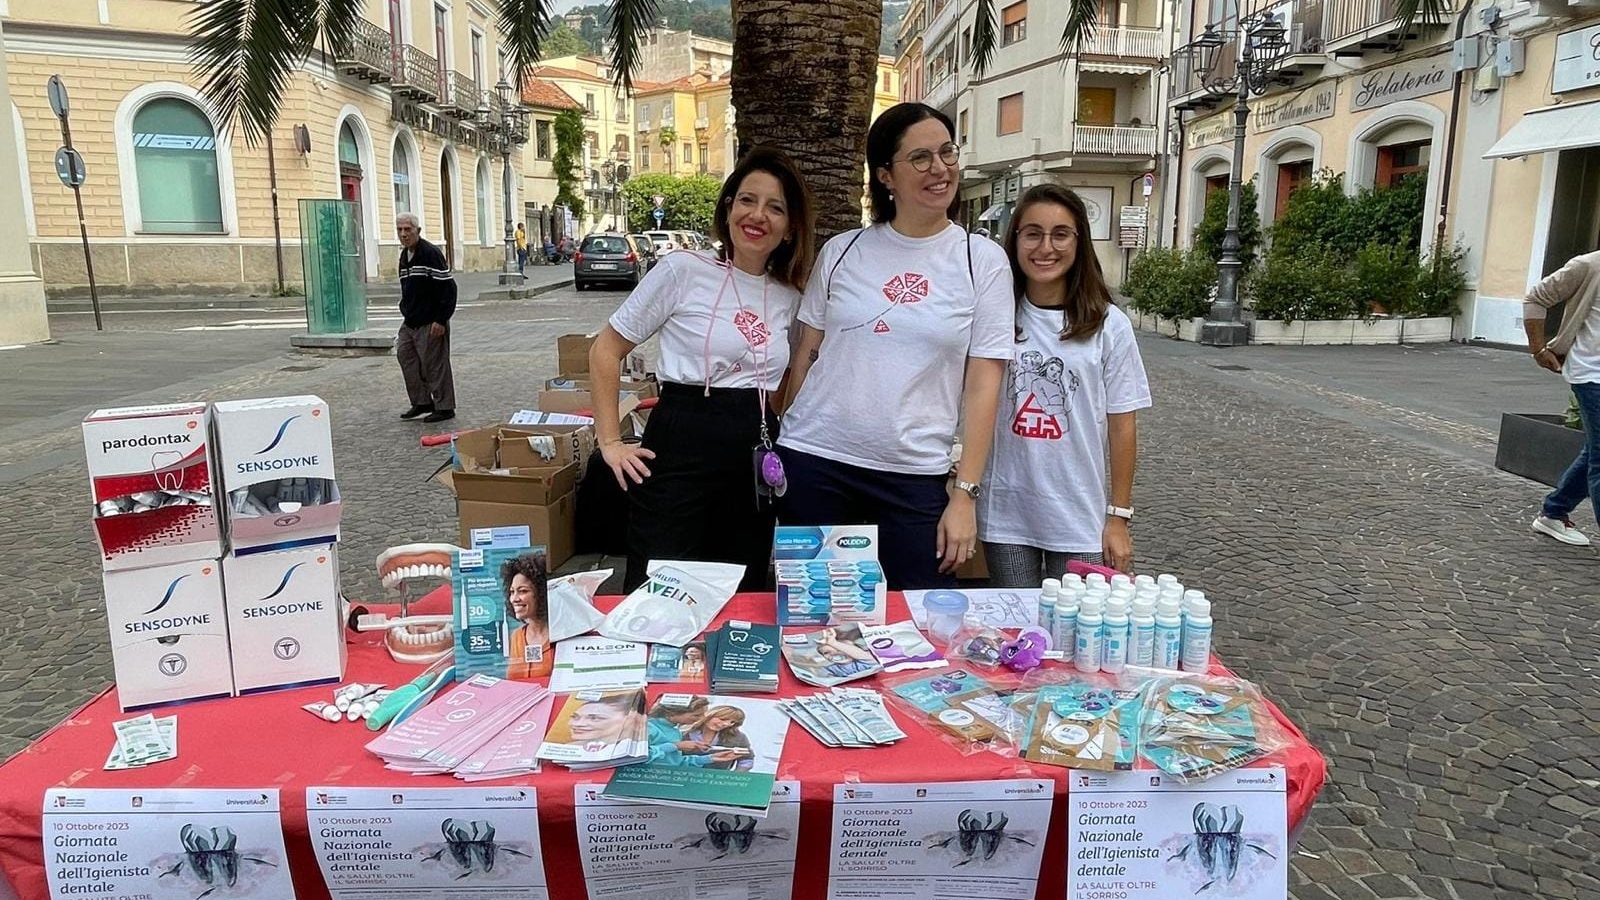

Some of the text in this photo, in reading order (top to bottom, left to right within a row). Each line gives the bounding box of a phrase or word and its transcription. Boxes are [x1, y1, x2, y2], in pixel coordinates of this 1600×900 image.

[1355, 65, 1445, 106] Gelateria
[1315, 91, 1331, 114] 1942
[102, 432, 191, 453] parodontax
[237, 455, 319, 474] SENSODYNE
[243, 601, 324, 619] SENSODYNE
[469, 605, 490, 617] 30%
[125, 613, 211, 634] SENSODYNE
[470, 635, 491, 647] 35%
[1078, 800, 1148, 809] 10 Ottobre 2023
[318, 817, 392, 825] 10 Ottobre 2023
[598, 812, 634, 820] Ottobre
[1078, 813, 1136, 826] Giornata
[53, 822, 129, 831] 10 Ottobre 2023
[587, 823, 647, 832] Giornata
[842, 818, 901, 827] Giornata
[320, 828, 382, 838] Giornata
[588, 833, 656, 844] Nazionale
[841, 829, 907, 838] Nazionale
[1078, 831, 1143, 842] Nazionale
[54, 835, 117, 847] Giornata
[323, 841, 392, 851] Nazionale
[840, 839, 922, 849] dell'Igienista
[589, 843, 673, 854] dell'Igienista
[839, 849, 888, 858] dentale
[55, 851, 128, 864] Nazionale
[326, 852, 413, 863] dell'Igienista
[591, 853, 640, 862] dentale
[1077, 848, 1160, 861] dell'Igienista
[330, 863, 381, 872] dentale
[1077, 865, 1126, 876] dentale
[57, 866, 150, 881] dell'Igienista
[60, 882, 115, 894] dentale
[1076, 881, 1156, 890] LA SALUTE OLTRE
[1076, 892, 1127, 900] IL SORRISO
